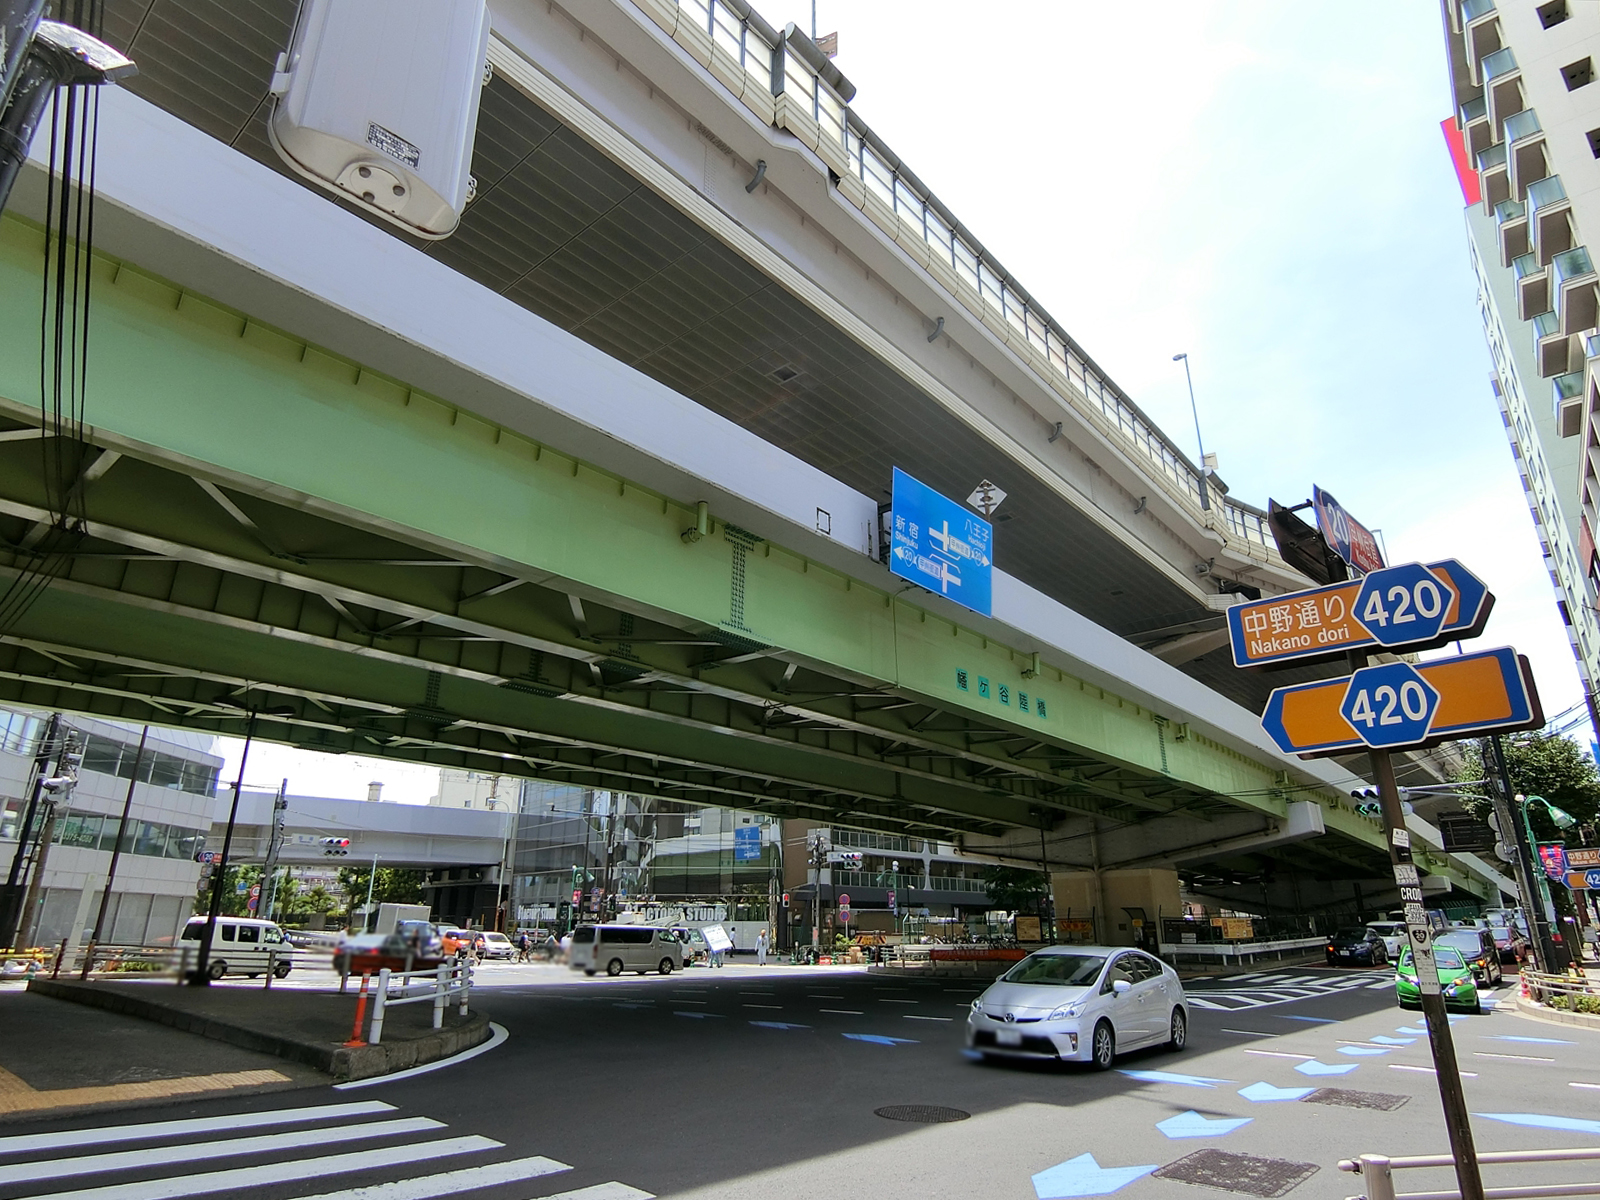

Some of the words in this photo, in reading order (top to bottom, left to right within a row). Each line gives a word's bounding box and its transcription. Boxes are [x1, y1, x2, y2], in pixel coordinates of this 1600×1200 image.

[895, 514, 919, 540] 新宿
[964, 518, 990, 542] 八王子
[1327, 502, 1348, 546] 20
[895, 530, 919, 550] Shinjuku
[904, 549, 913, 560] 20
[973, 550, 983, 560] 20
[1363, 579, 1442, 627] 420
[1244, 594, 1345, 639] 中野通り
[1250, 635, 1311, 655] Nakano
[1317, 624, 1350, 643] dori
[1351, 680, 1428, 728] 420
[1567, 851, 1597, 860] 中野通り
[1587, 874, 1600, 885] 42
[686, 907, 727, 921] STUDIO
[1415, 932, 1425, 940] 20
